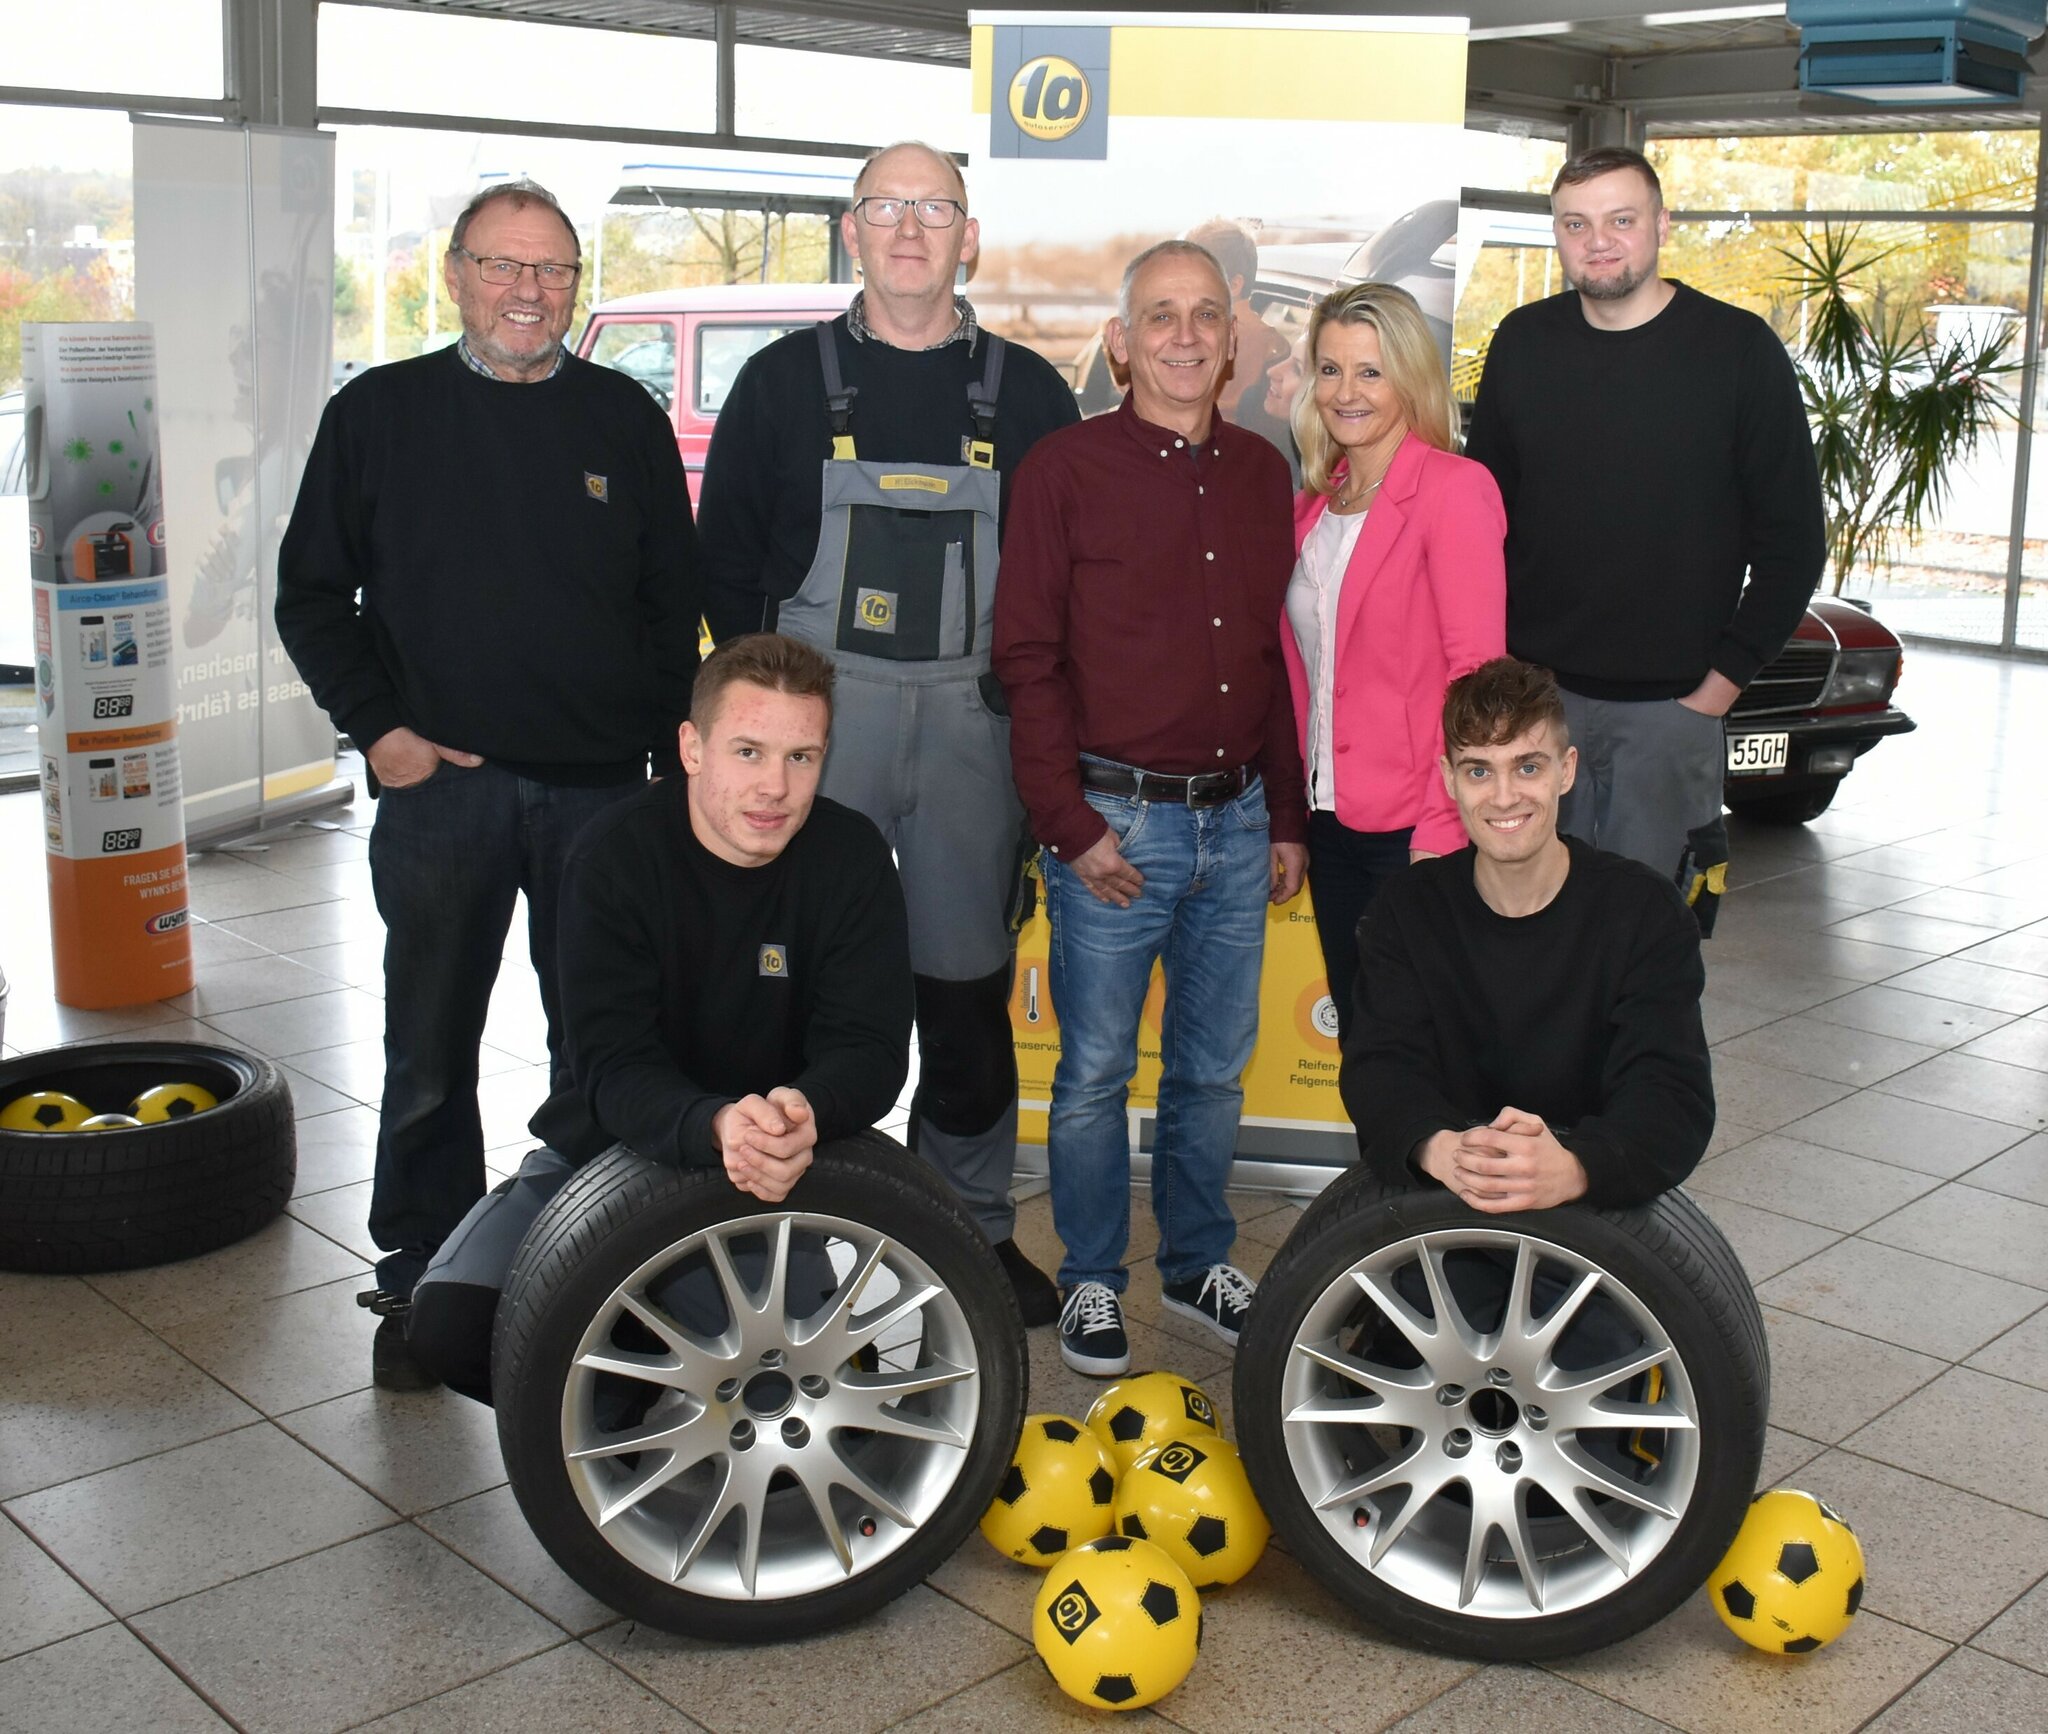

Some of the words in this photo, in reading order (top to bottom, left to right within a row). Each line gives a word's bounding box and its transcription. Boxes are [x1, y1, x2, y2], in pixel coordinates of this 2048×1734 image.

[1018, 64, 1083, 121] 1a
[123, 871, 158, 887] FRAGEN
[1298, 1058, 1339, 1071] Reifen-
